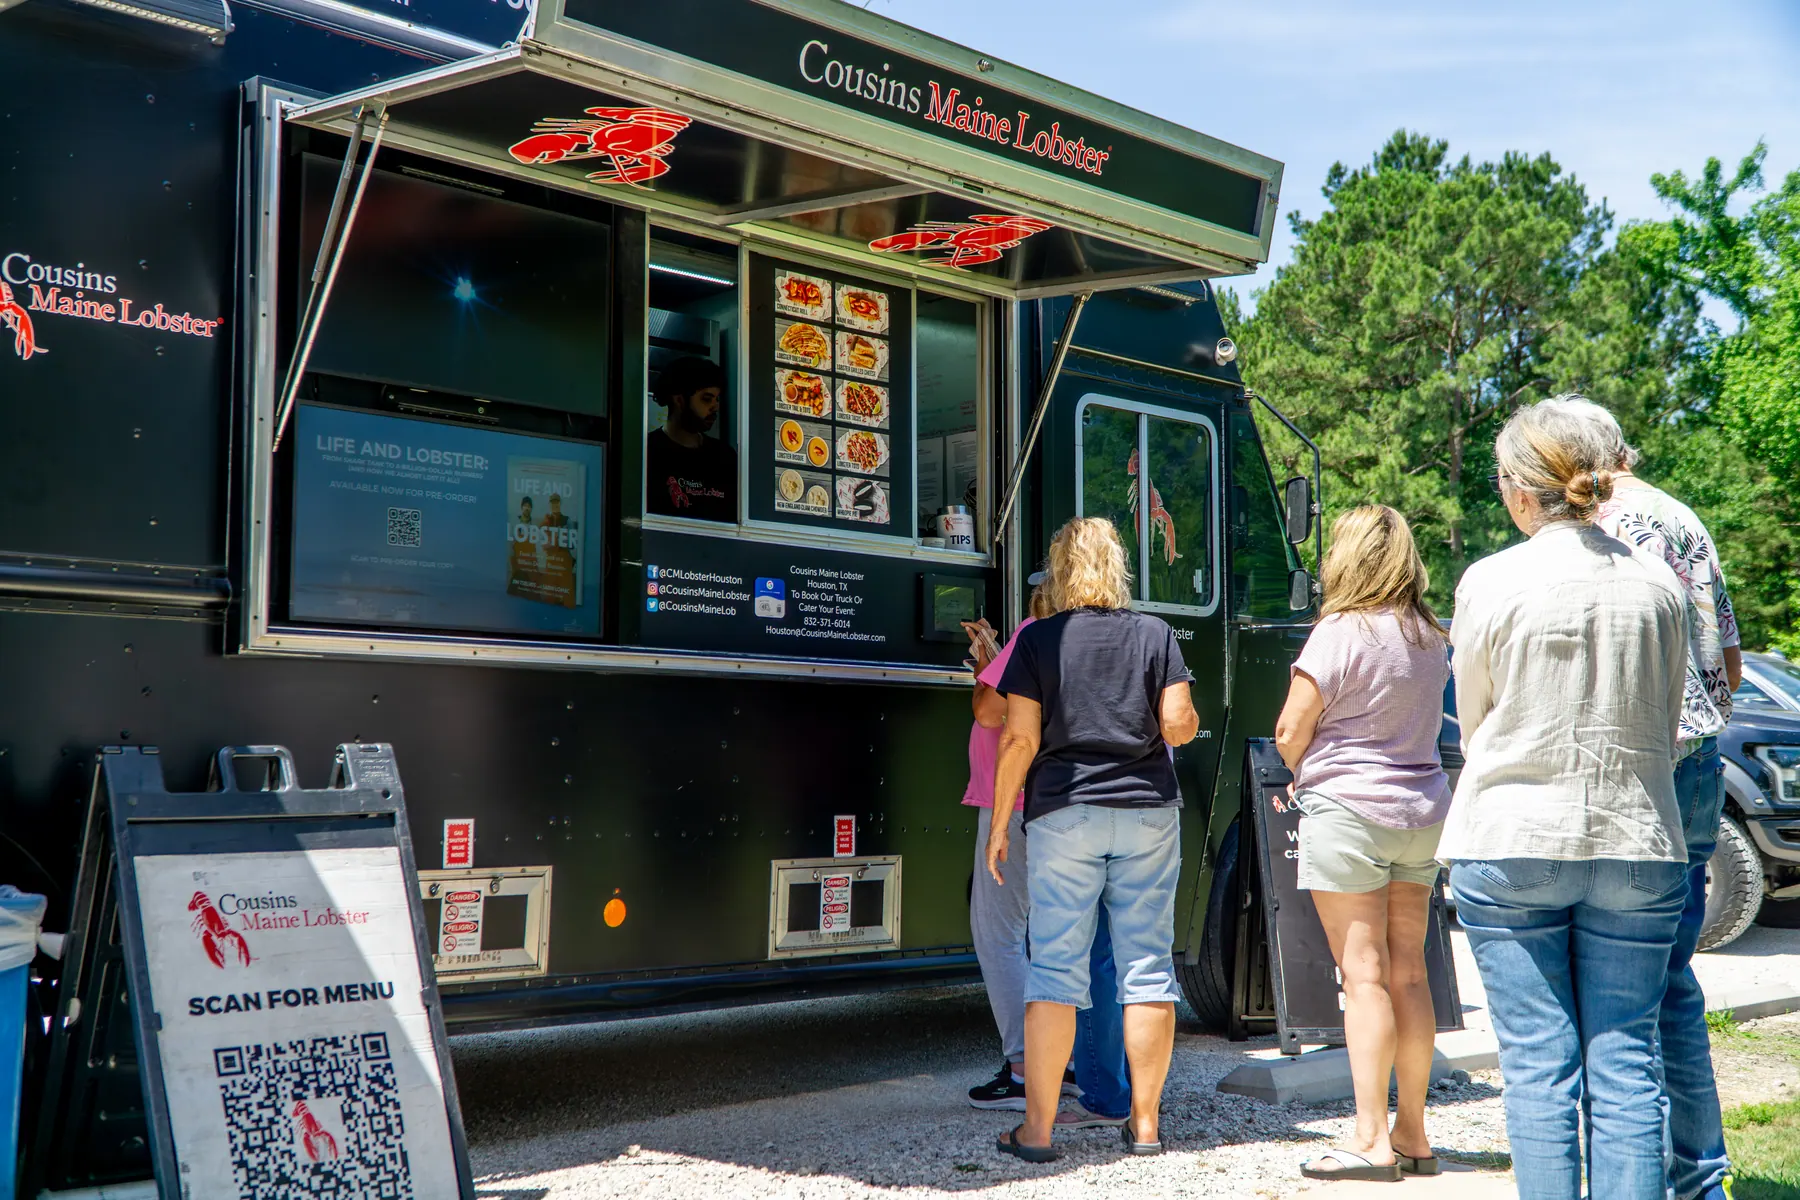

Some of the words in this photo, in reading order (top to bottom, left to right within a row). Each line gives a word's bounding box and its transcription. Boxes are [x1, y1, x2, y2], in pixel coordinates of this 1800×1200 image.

[799, 39, 922, 114] Cousins
[923, 80, 1011, 145] Maine
[1012, 110, 1109, 175] Lobster
[2, 253, 117, 293] Cousins
[28, 284, 115, 322] Maine
[118, 298, 218, 337] Lobster
[316, 434, 356, 455] LIFE
[360, 440, 402, 460] AND
[406, 446, 489, 471] LOBSTER:
[329, 480, 380, 494] AVAILABLE
[381, 486, 404, 497] NOW
[406, 488, 424, 499] FOR
[514, 478, 540, 496] LIFE
[542, 481, 573, 499] AND
[506, 523, 578, 550] LOBSTER
[950, 534, 970, 544] TIPS
[658, 568, 743, 585] @CMLobsterHouston
[790, 566, 817, 578] Cousins
[818, 568, 838, 579] Maine
[840, 570, 864, 581] Lobster
[658, 584, 751, 602] @CousinsMaineLobster
[807, 580, 838, 592] Houston,
[839, 582, 848, 591] TX
[791, 590, 800, 599] To
[801, 590, 820, 602] Book
[820, 592, 834, 602] Our
[835, 594, 853, 604] Truck
[854, 596, 863, 604] Or
[658, 600, 737, 616] @CousinsMaineLob
[798, 603, 817, 614] Cater
[818, 604, 834, 615] Your
[836, 606, 856, 616] Event:
[804, 616, 850, 628] 832-371-6014
[766, 626, 886, 643] Houston@CousinsMaineLobster.com
[1171, 626, 1194, 640] bster
[219, 890, 298, 915] Cousins
[450, 893, 476, 902] DANGER
[826, 904, 846, 912] PELIGRO
[241, 911, 301, 932] Maine
[302, 908, 370, 928] Lobster
[447, 924, 474, 932] PELIGRO
[188, 992, 262, 1016] SCAN
[267, 987, 320, 1010] FOR
[324, 982, 394, 1004] MENU
